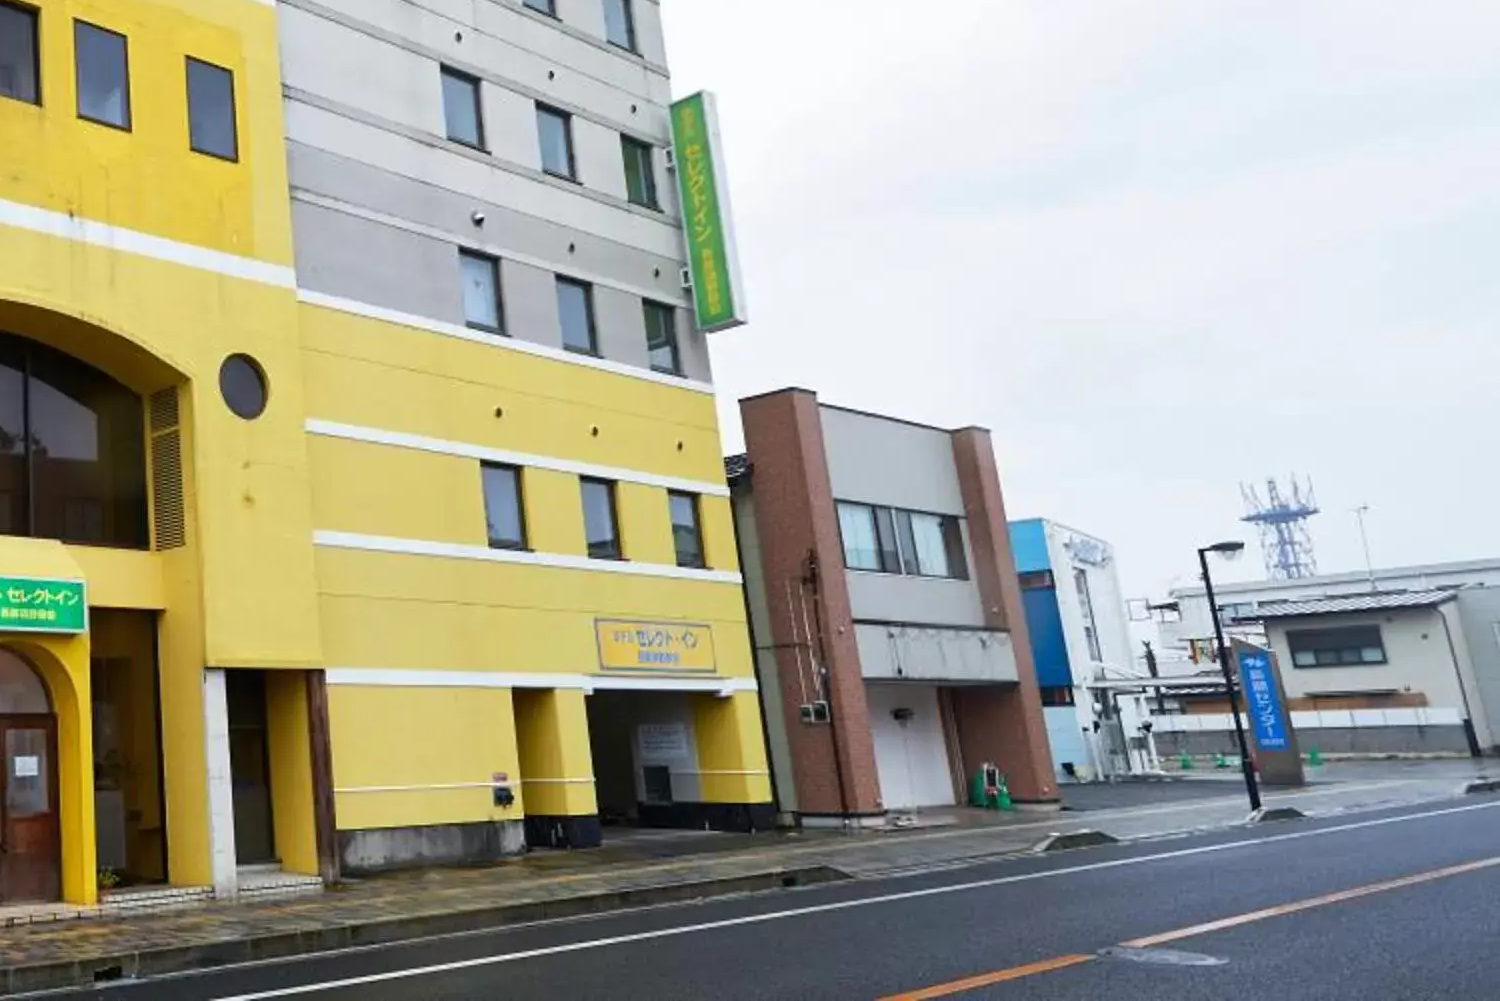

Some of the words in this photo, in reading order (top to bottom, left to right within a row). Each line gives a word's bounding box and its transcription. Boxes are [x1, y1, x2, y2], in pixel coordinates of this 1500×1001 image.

[6, 586, 80, 607] セレクトイン
